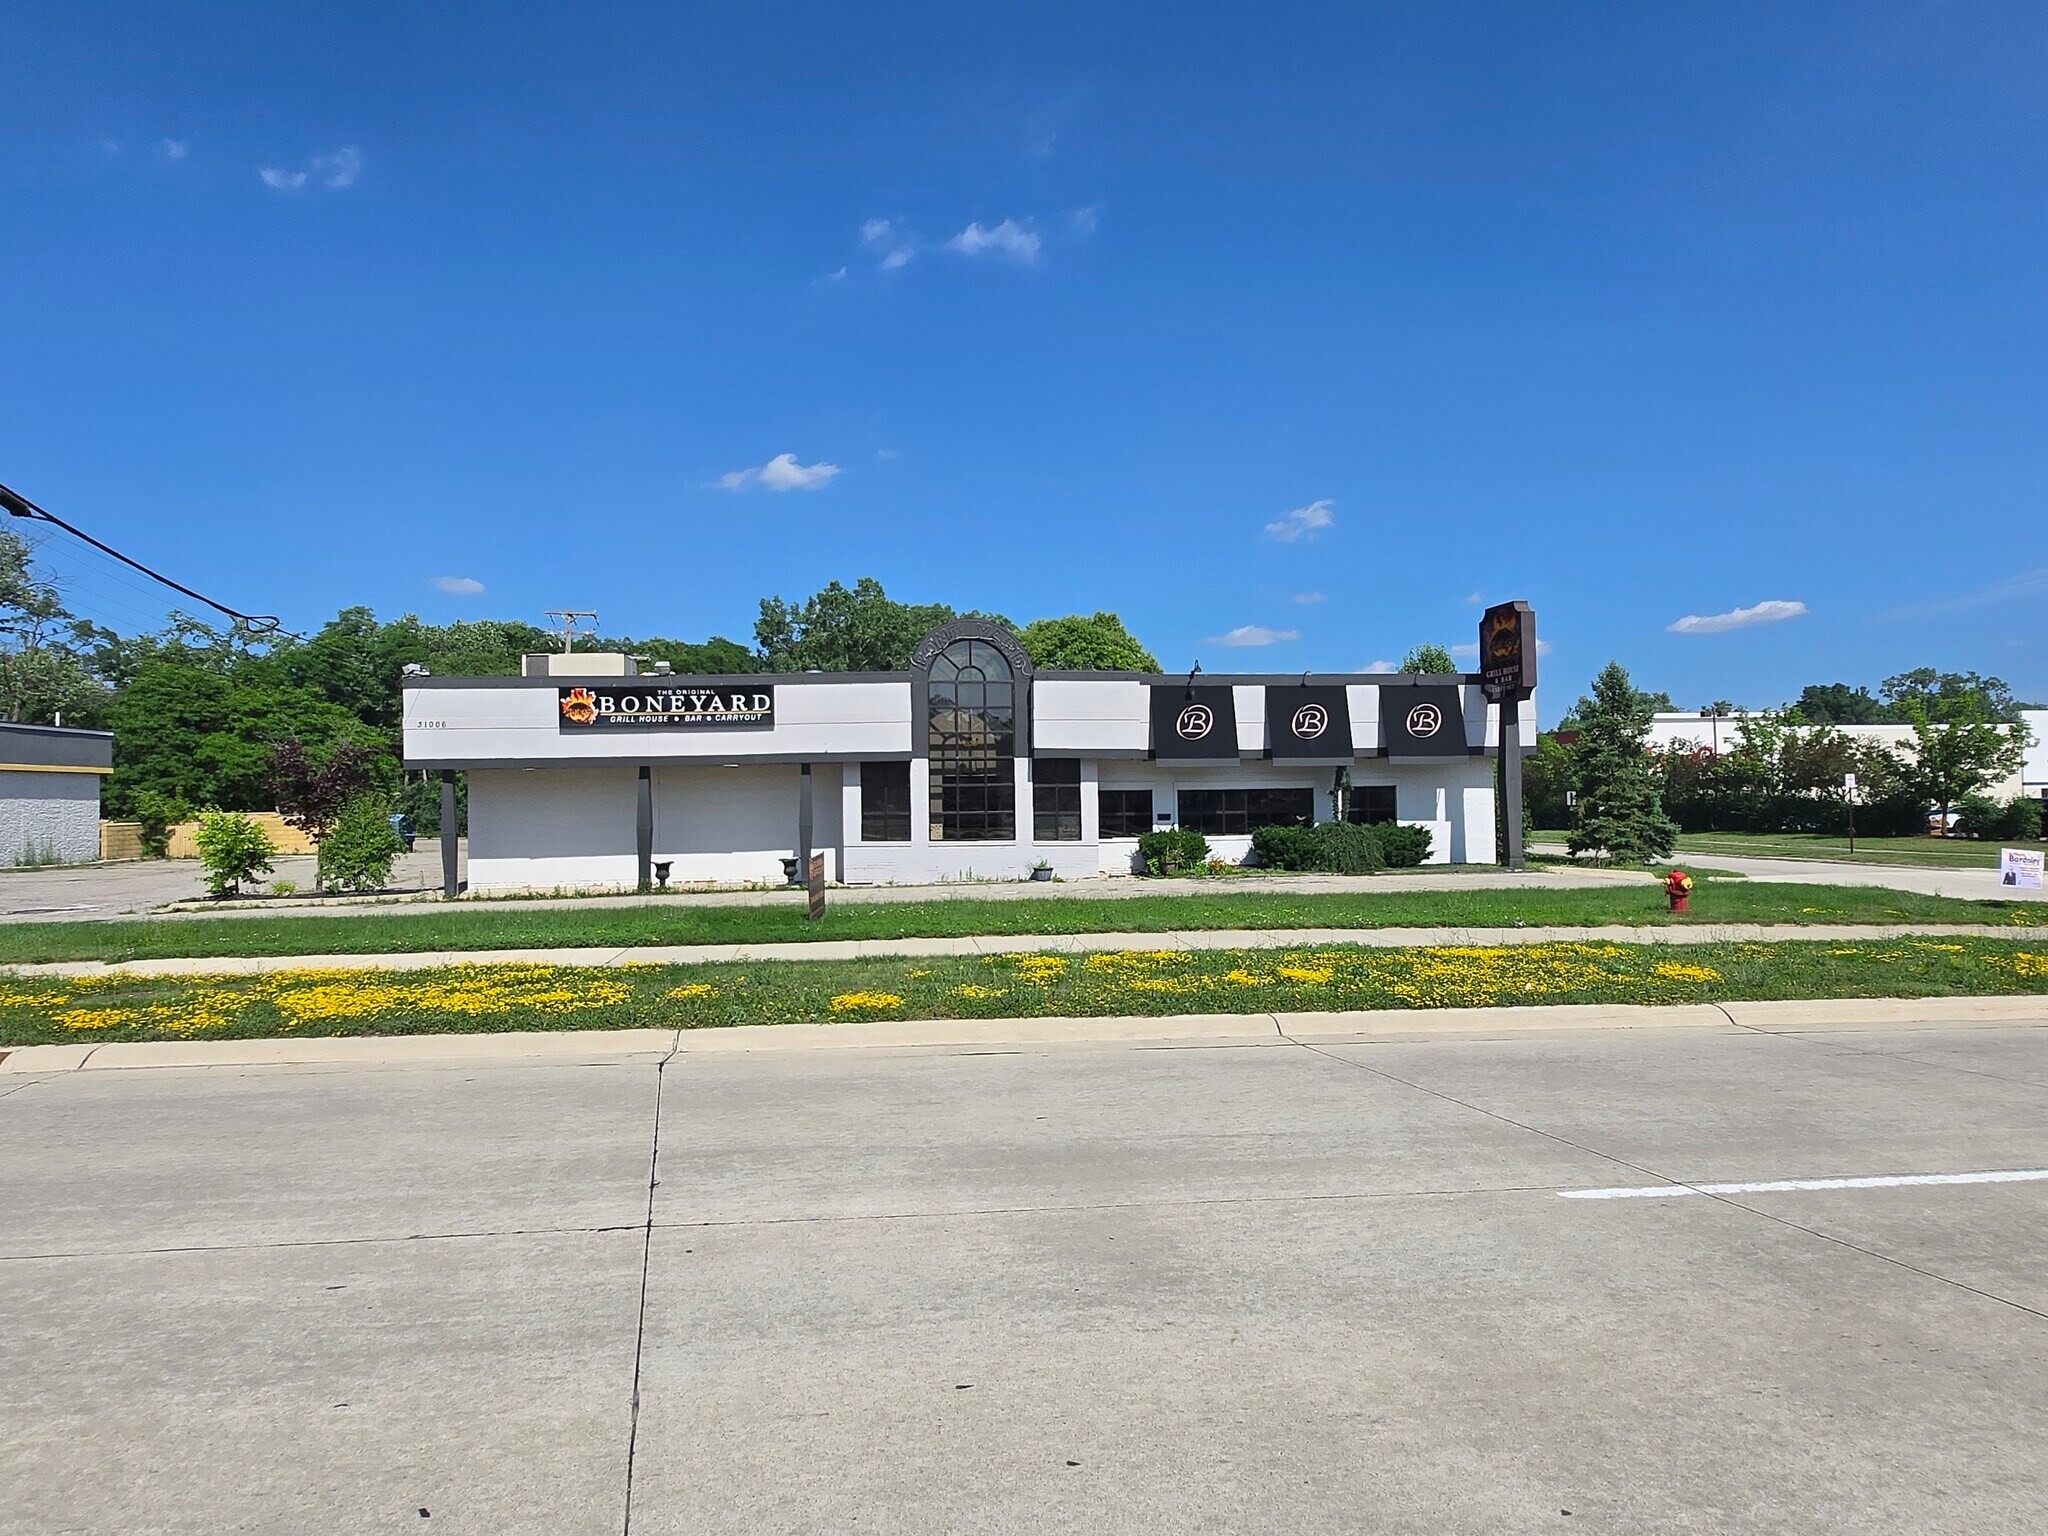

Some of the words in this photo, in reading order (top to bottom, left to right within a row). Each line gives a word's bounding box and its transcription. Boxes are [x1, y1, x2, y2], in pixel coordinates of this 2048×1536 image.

[598, 694, 771, 713] BONEYARD
[609, 715, 636, 723] GRILL
[638, 715, 669, 723] HOUSE
[684, 714, 702, 722] BAR
[714, 713, 762, 722] CARRYOUT
[1181, 711, 1206, 733] B
[1297, 710, 1321, 732] B
[1411, 710, 1435, 731] B
